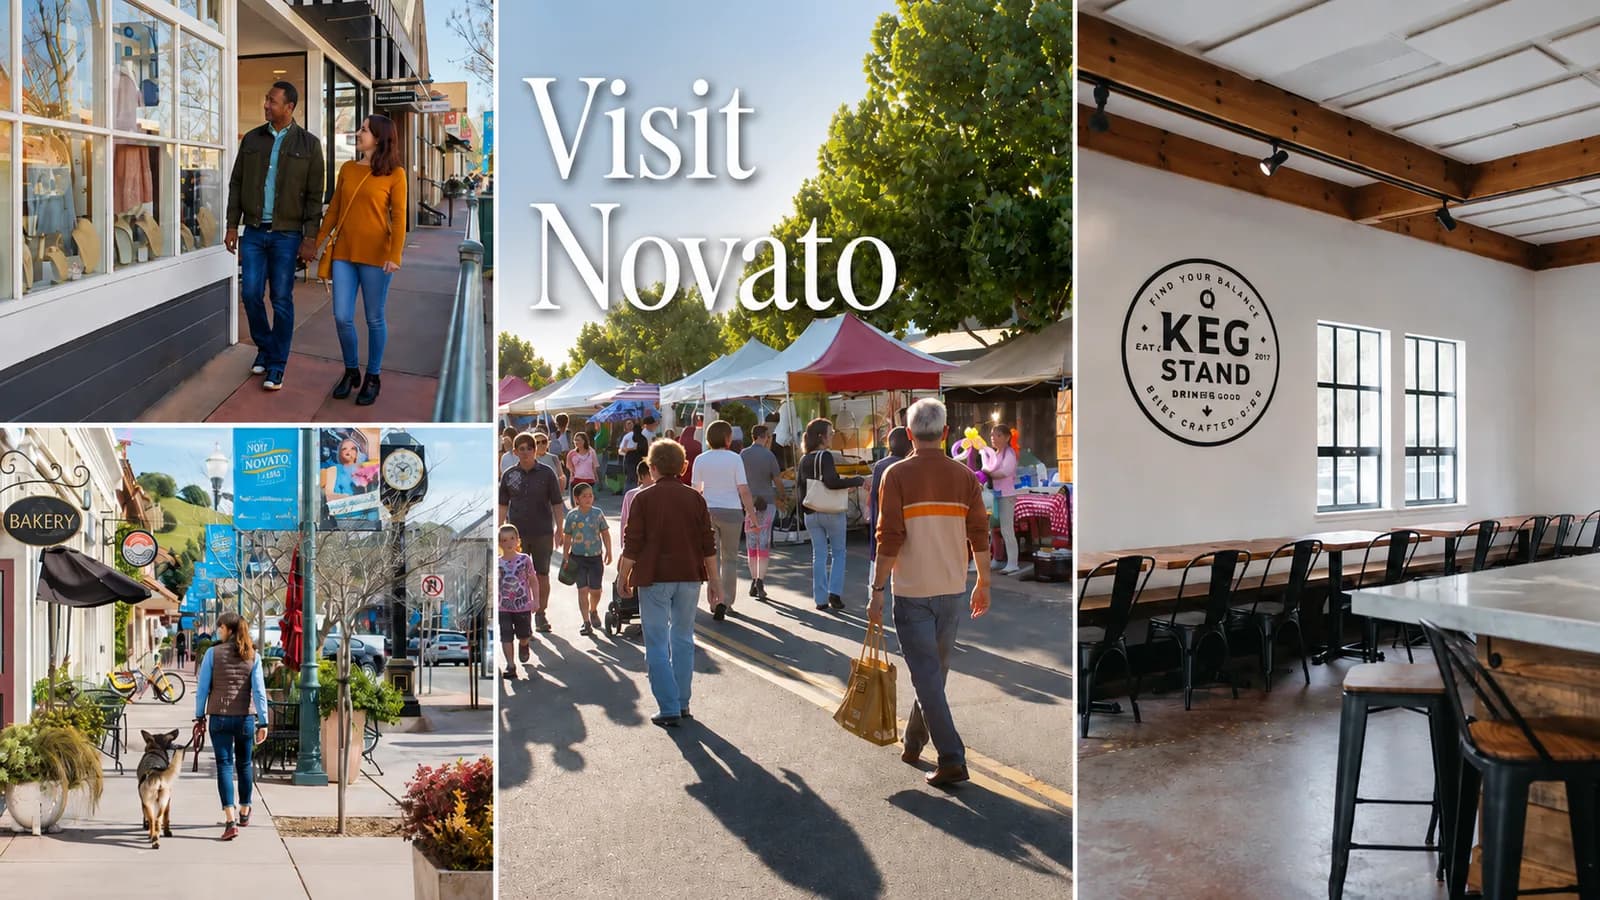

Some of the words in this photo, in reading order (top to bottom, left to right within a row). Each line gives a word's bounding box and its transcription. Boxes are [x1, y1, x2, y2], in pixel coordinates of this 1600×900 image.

[1149, 281, 1175, 307] FIND
[1179, 273, 1211, 284] YOUR
[1217, 277, 1261, 319] BALANCE
[1160, 311, 1250, 357] KEG
[1161, 358, 1251, 386] STAND
[1217, 393, 1241, 401] GOOD
[1180, 418, 1235, 432] CRAFTED
[245, 454, 290, 470] NOVATO
[9, 512, 76, 530] BAKERY
